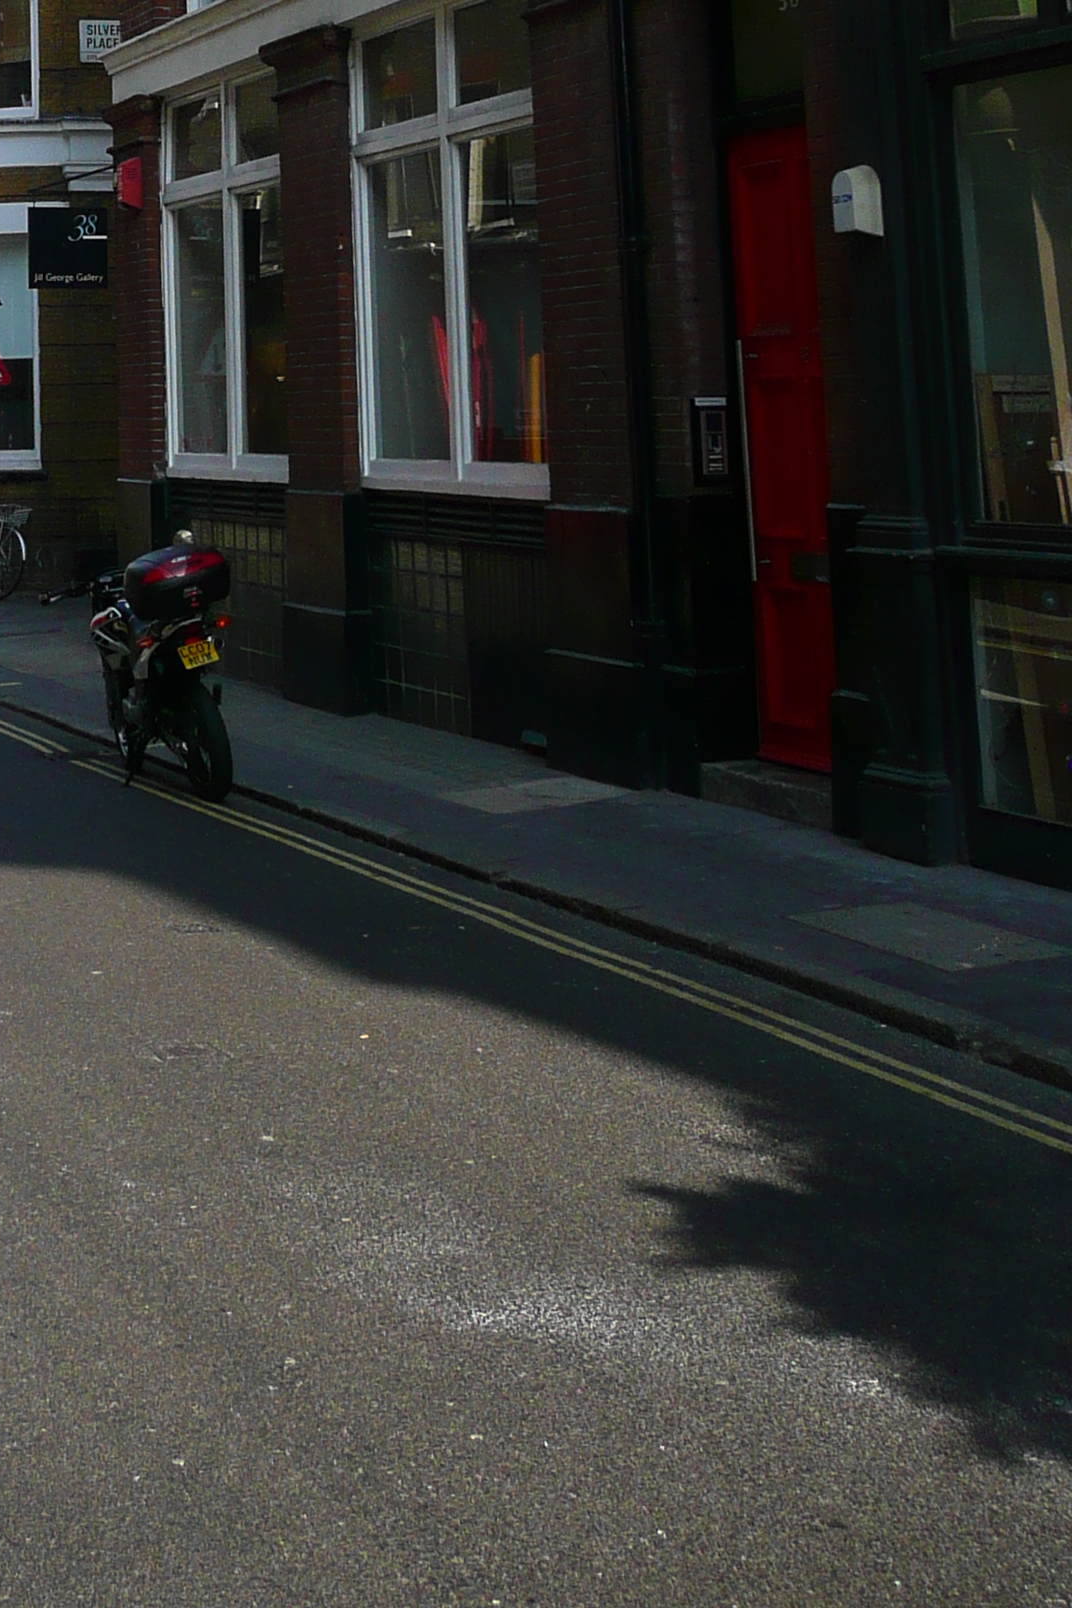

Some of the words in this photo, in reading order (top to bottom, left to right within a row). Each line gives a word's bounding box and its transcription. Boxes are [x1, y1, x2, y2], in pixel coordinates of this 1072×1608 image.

[67, 214, 98, 242] 38
[34, 273, 44, 284] Jill
[45, 273, 75, 284] George
[76, 273, 104, 284] Gallery
